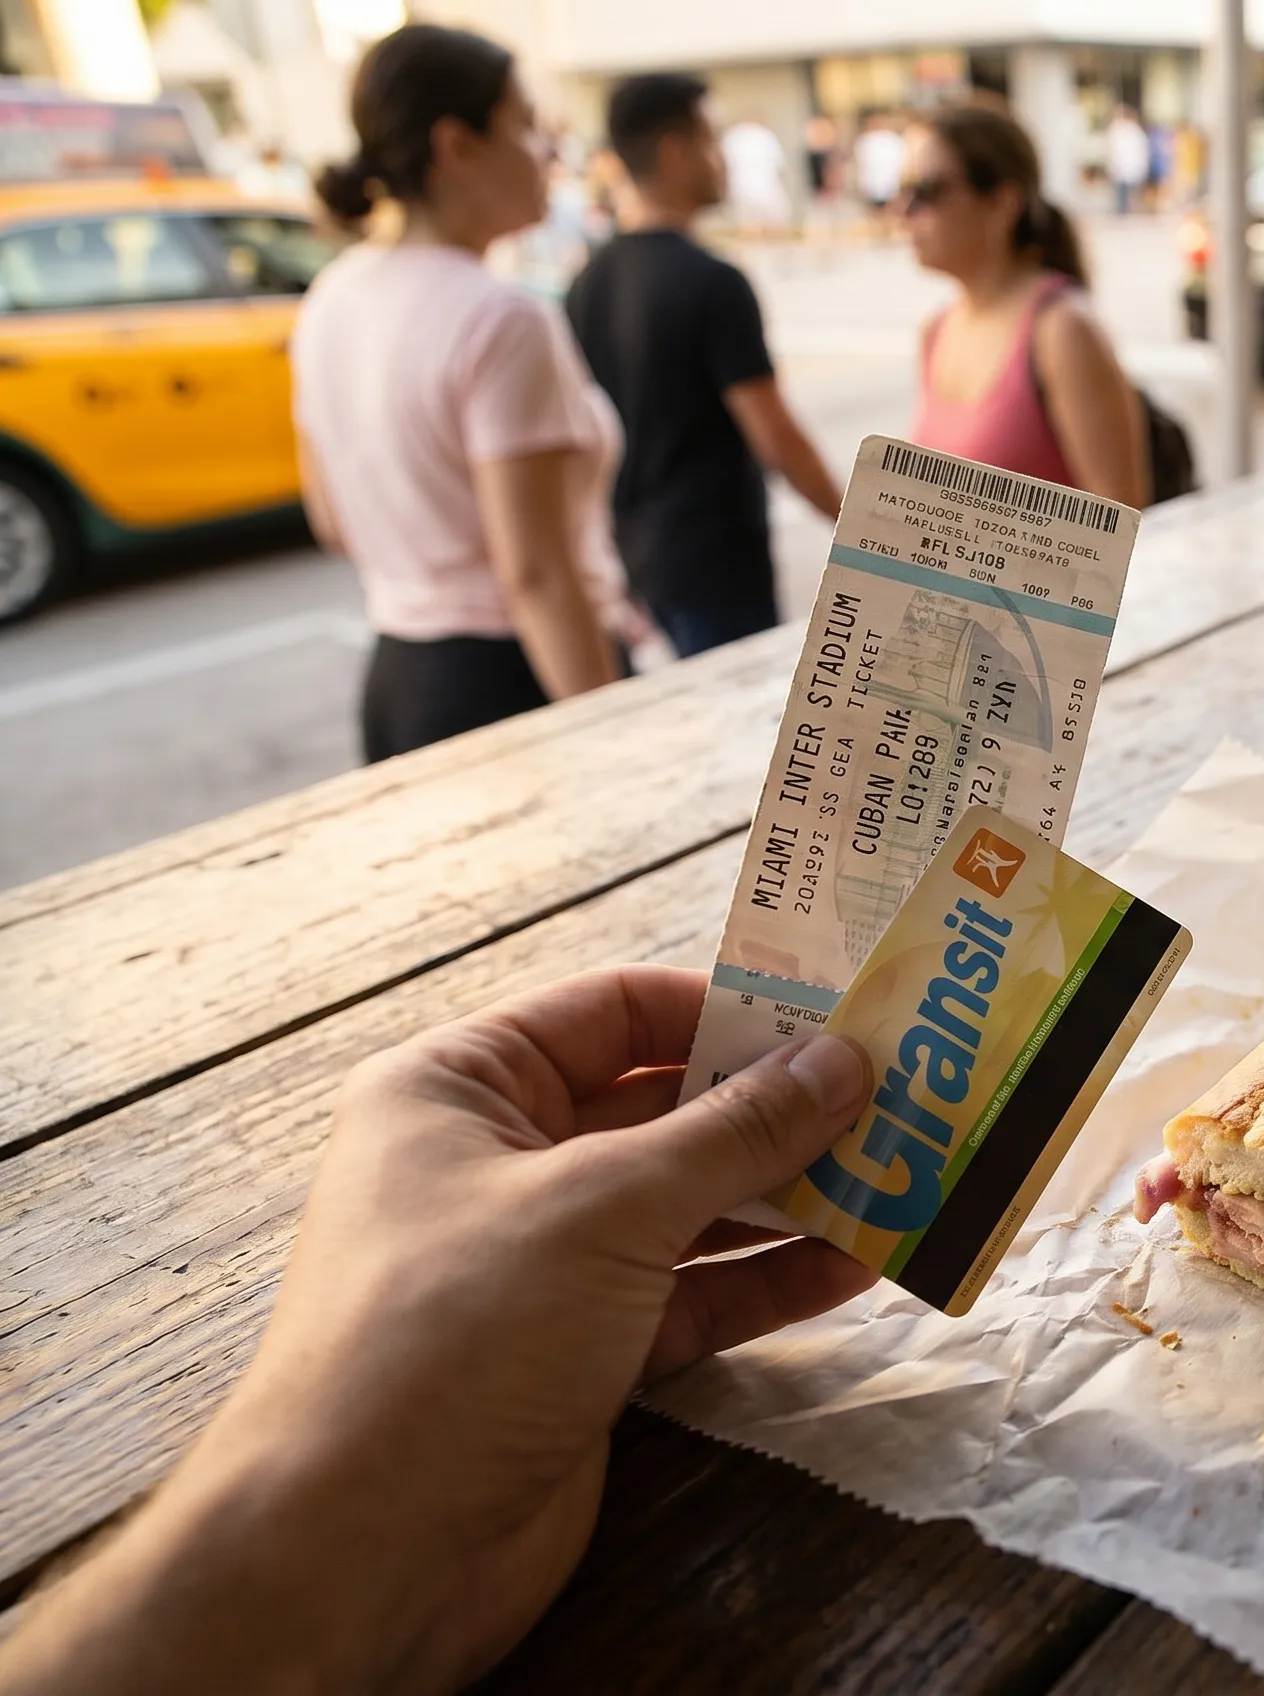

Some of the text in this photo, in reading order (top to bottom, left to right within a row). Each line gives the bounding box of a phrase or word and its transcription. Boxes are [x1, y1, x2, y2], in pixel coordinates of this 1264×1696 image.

[750, 592, 862, 911] MIAMI INTER STADIUM
[829, 737, 855, 778] GEA
[846, 628, 883, 709] TICKET
[851, 773, 895, 855] CUBAN
